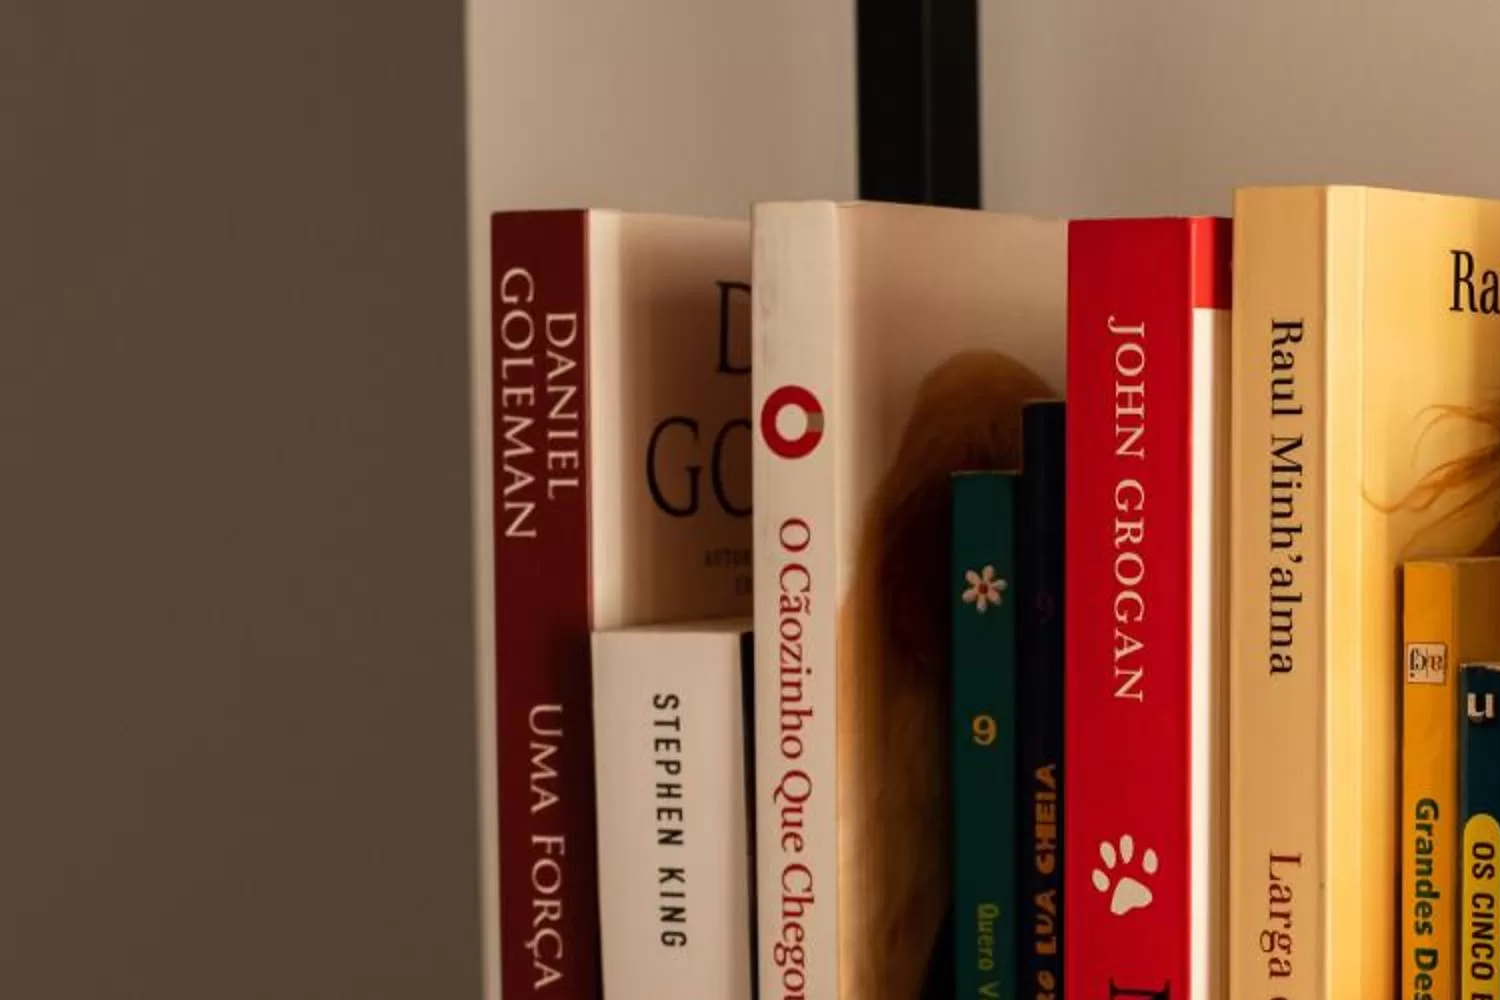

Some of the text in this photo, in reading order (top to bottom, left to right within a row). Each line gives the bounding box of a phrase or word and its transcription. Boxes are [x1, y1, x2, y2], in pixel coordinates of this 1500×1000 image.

[500, 267, 537, 539] GOLEMAN
[545, 312, 579, 500] DANIEL
[778, 517, 811, 552] O
[1107, 315, 1145, 702] JOHN GROGAN
[1270, 319, 1304, 676] Raul Minh'alma
[778, 564, 814, 759] Cãozinho
[528, 704, 563, 815] UMA
[972, 715, 997, 745] 9
[652, 693, 688, 948] STEPHEN KING
[774, 770, 812, 853] Que
[1414, 798, 1441, 936] Grandes
[1471, 841, 1495, 880] OS
[524, 834, 566, 990] FORÇA
[976, 903, 1001, 972] Quero
[1260, 851, 1302, 980] Larga
[1471, 894, 1495, 981] CINCO
